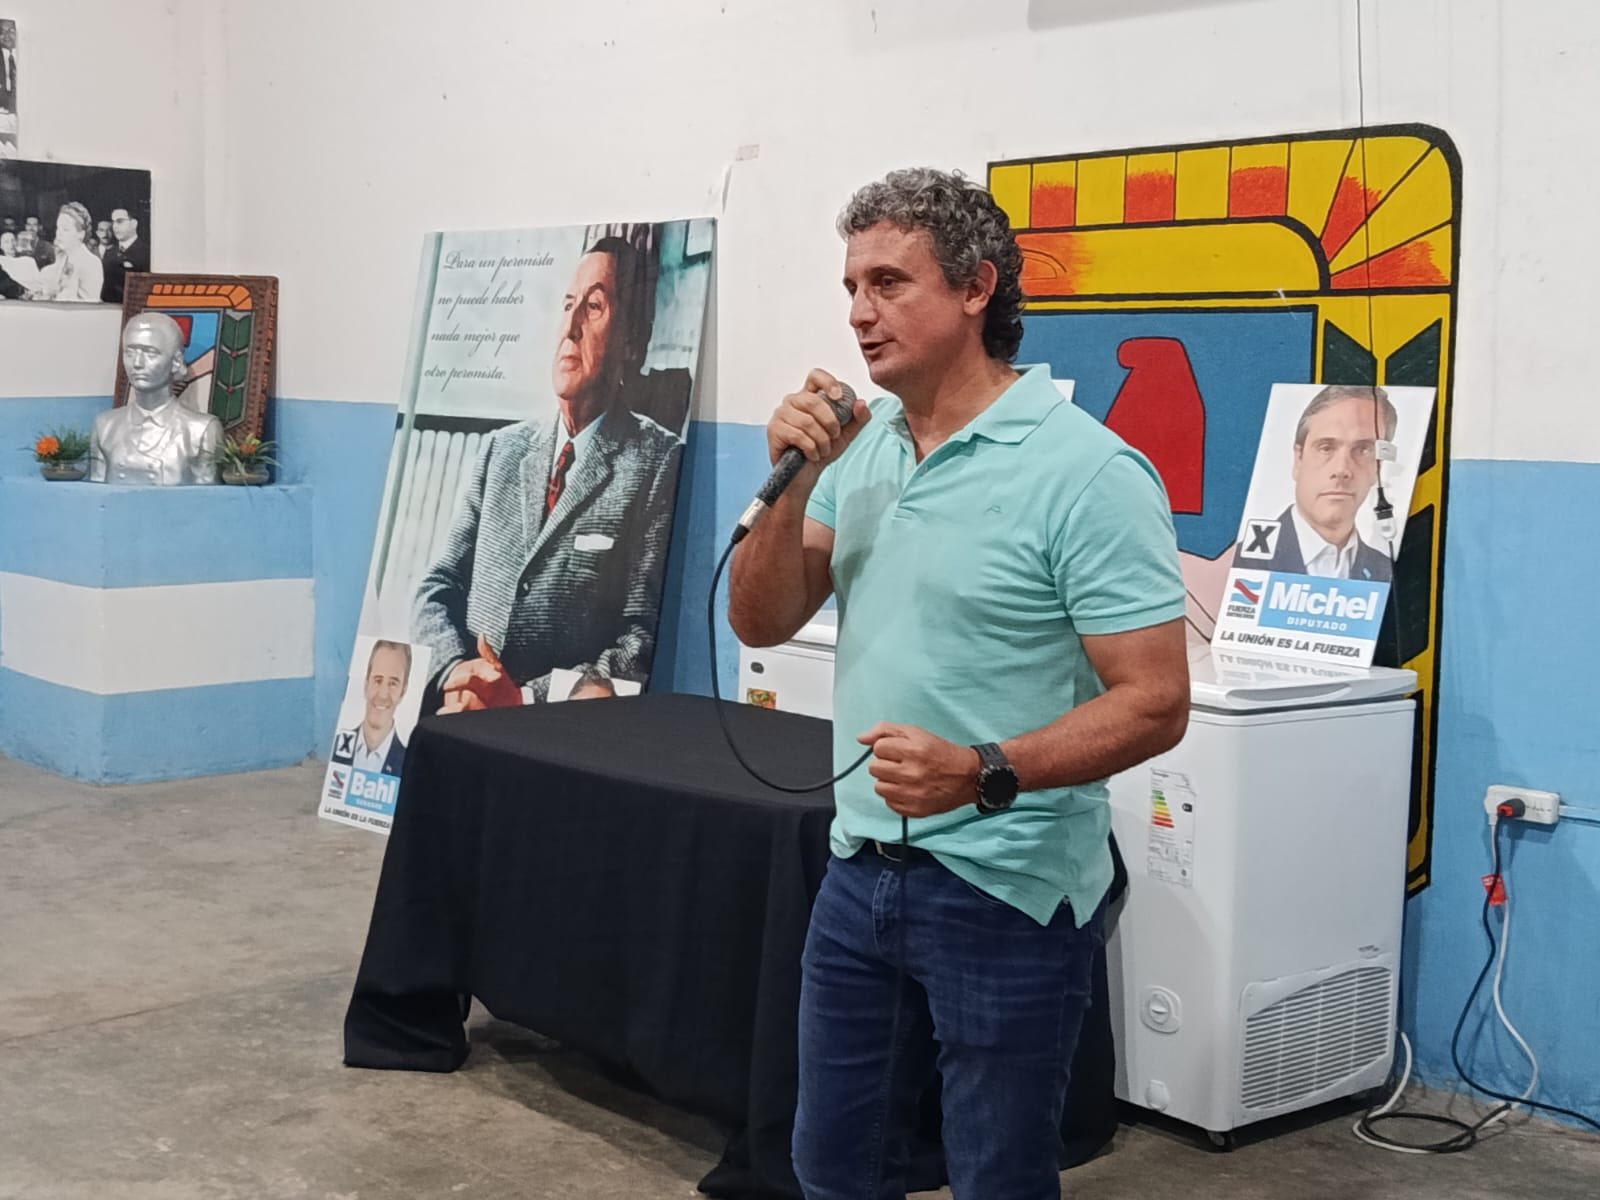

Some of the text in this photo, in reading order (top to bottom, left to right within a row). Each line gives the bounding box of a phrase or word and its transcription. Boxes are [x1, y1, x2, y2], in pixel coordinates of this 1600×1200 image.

[443, 251, 554, 283] Para un peronista
[438, 280, 524, 320] no puede haber
[431, 323, 520, 358] nada mejor que
[424, 365, 506, 392] otro peronista.
[1246, 524, 1277, 554] X
[1268, 581, 1379, 621] Michel
[1286, 616, 1348, 631] DIPUTADO
[1220, 631, 1361, 658] LA UNIÓN ES LA FUERZA
[340, 733, 354, 753] X
[350, 772, 397, 804] Bahl
